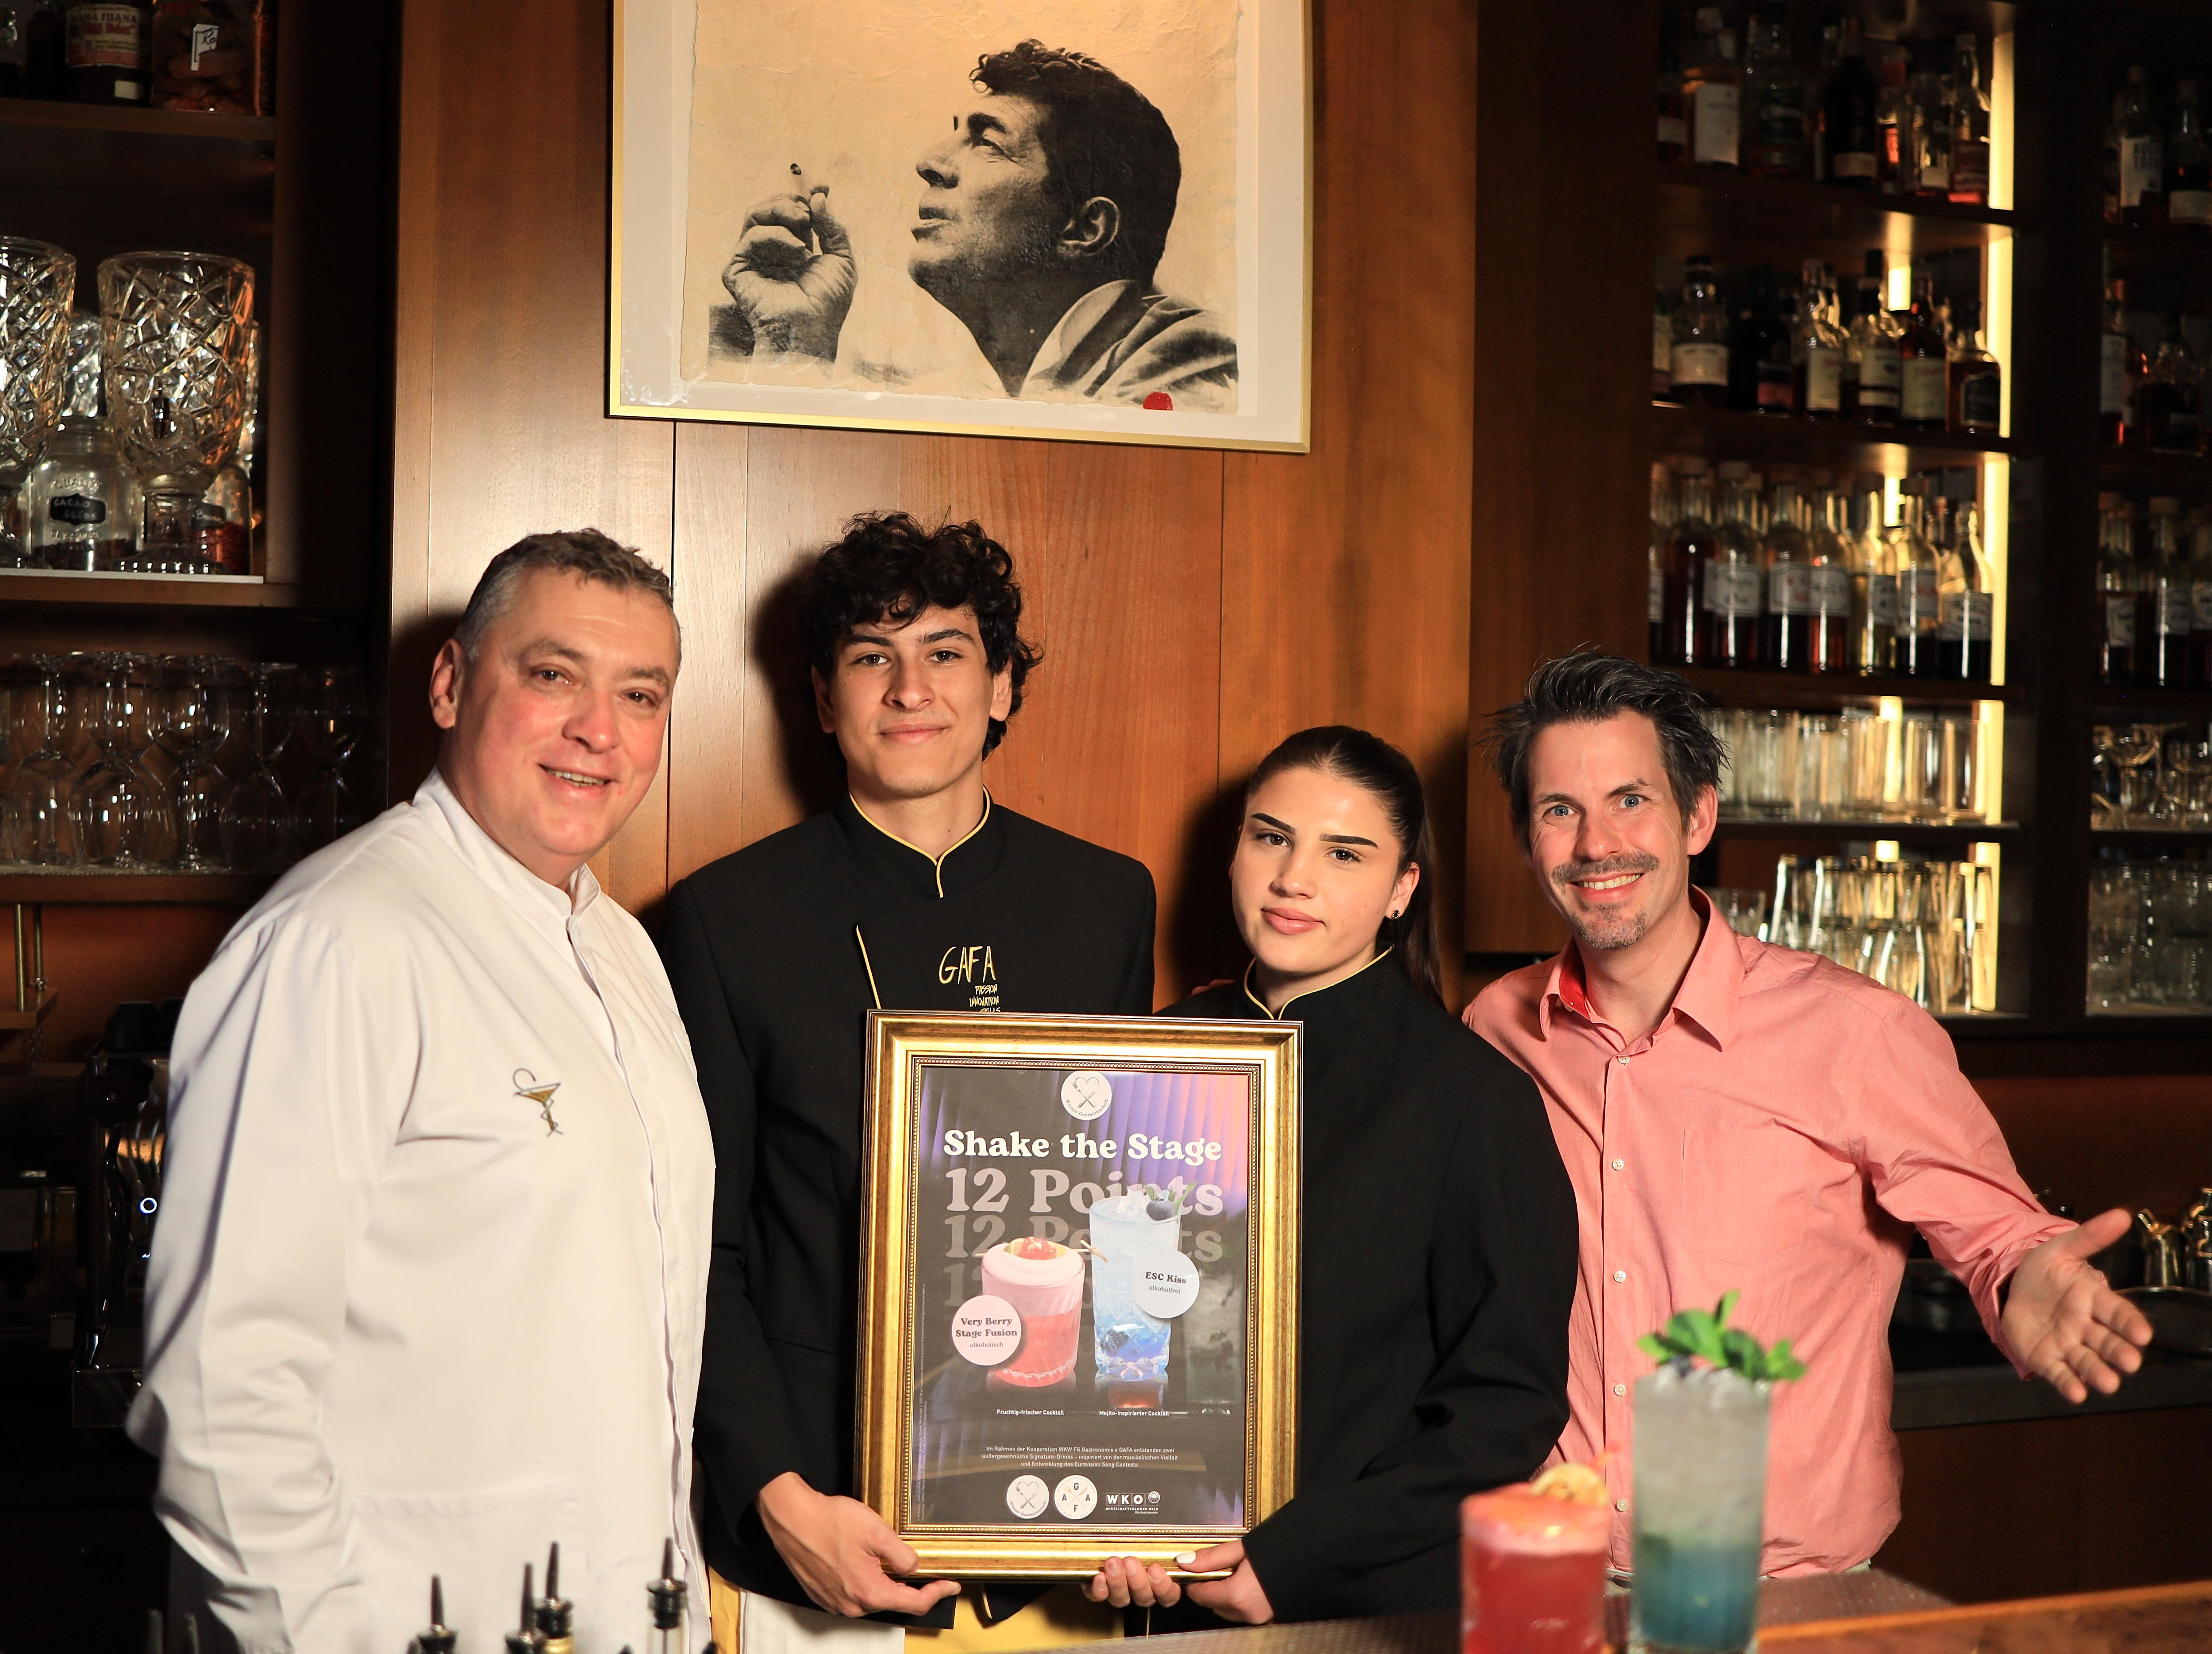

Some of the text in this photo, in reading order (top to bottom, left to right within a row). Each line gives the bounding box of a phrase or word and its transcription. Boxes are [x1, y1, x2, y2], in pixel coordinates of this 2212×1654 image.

[54, 498, 91, 508] CACAO
[939, 945, 996, 984] GAFA
[975, 983, 997, 995] PASSION
[969, 995, 999, 1007] INNOVATION
[1066, 1099, 1108, 1117] Wiener Gastwirtschaft
[943, 1129, 1223, 1166] Shake the Stage
[945, 1167, 1009, 1213] 12
[1145, 1271, 1187, 1284] ESC Kiss
[1149, 1285, 1181, 1294] alkoholfrei
[961, 1317, 1012, 1326] Very Berry
[955, 1329, 982, 1338] Stage
[1107, 1494, 1143, 1505] WKO
